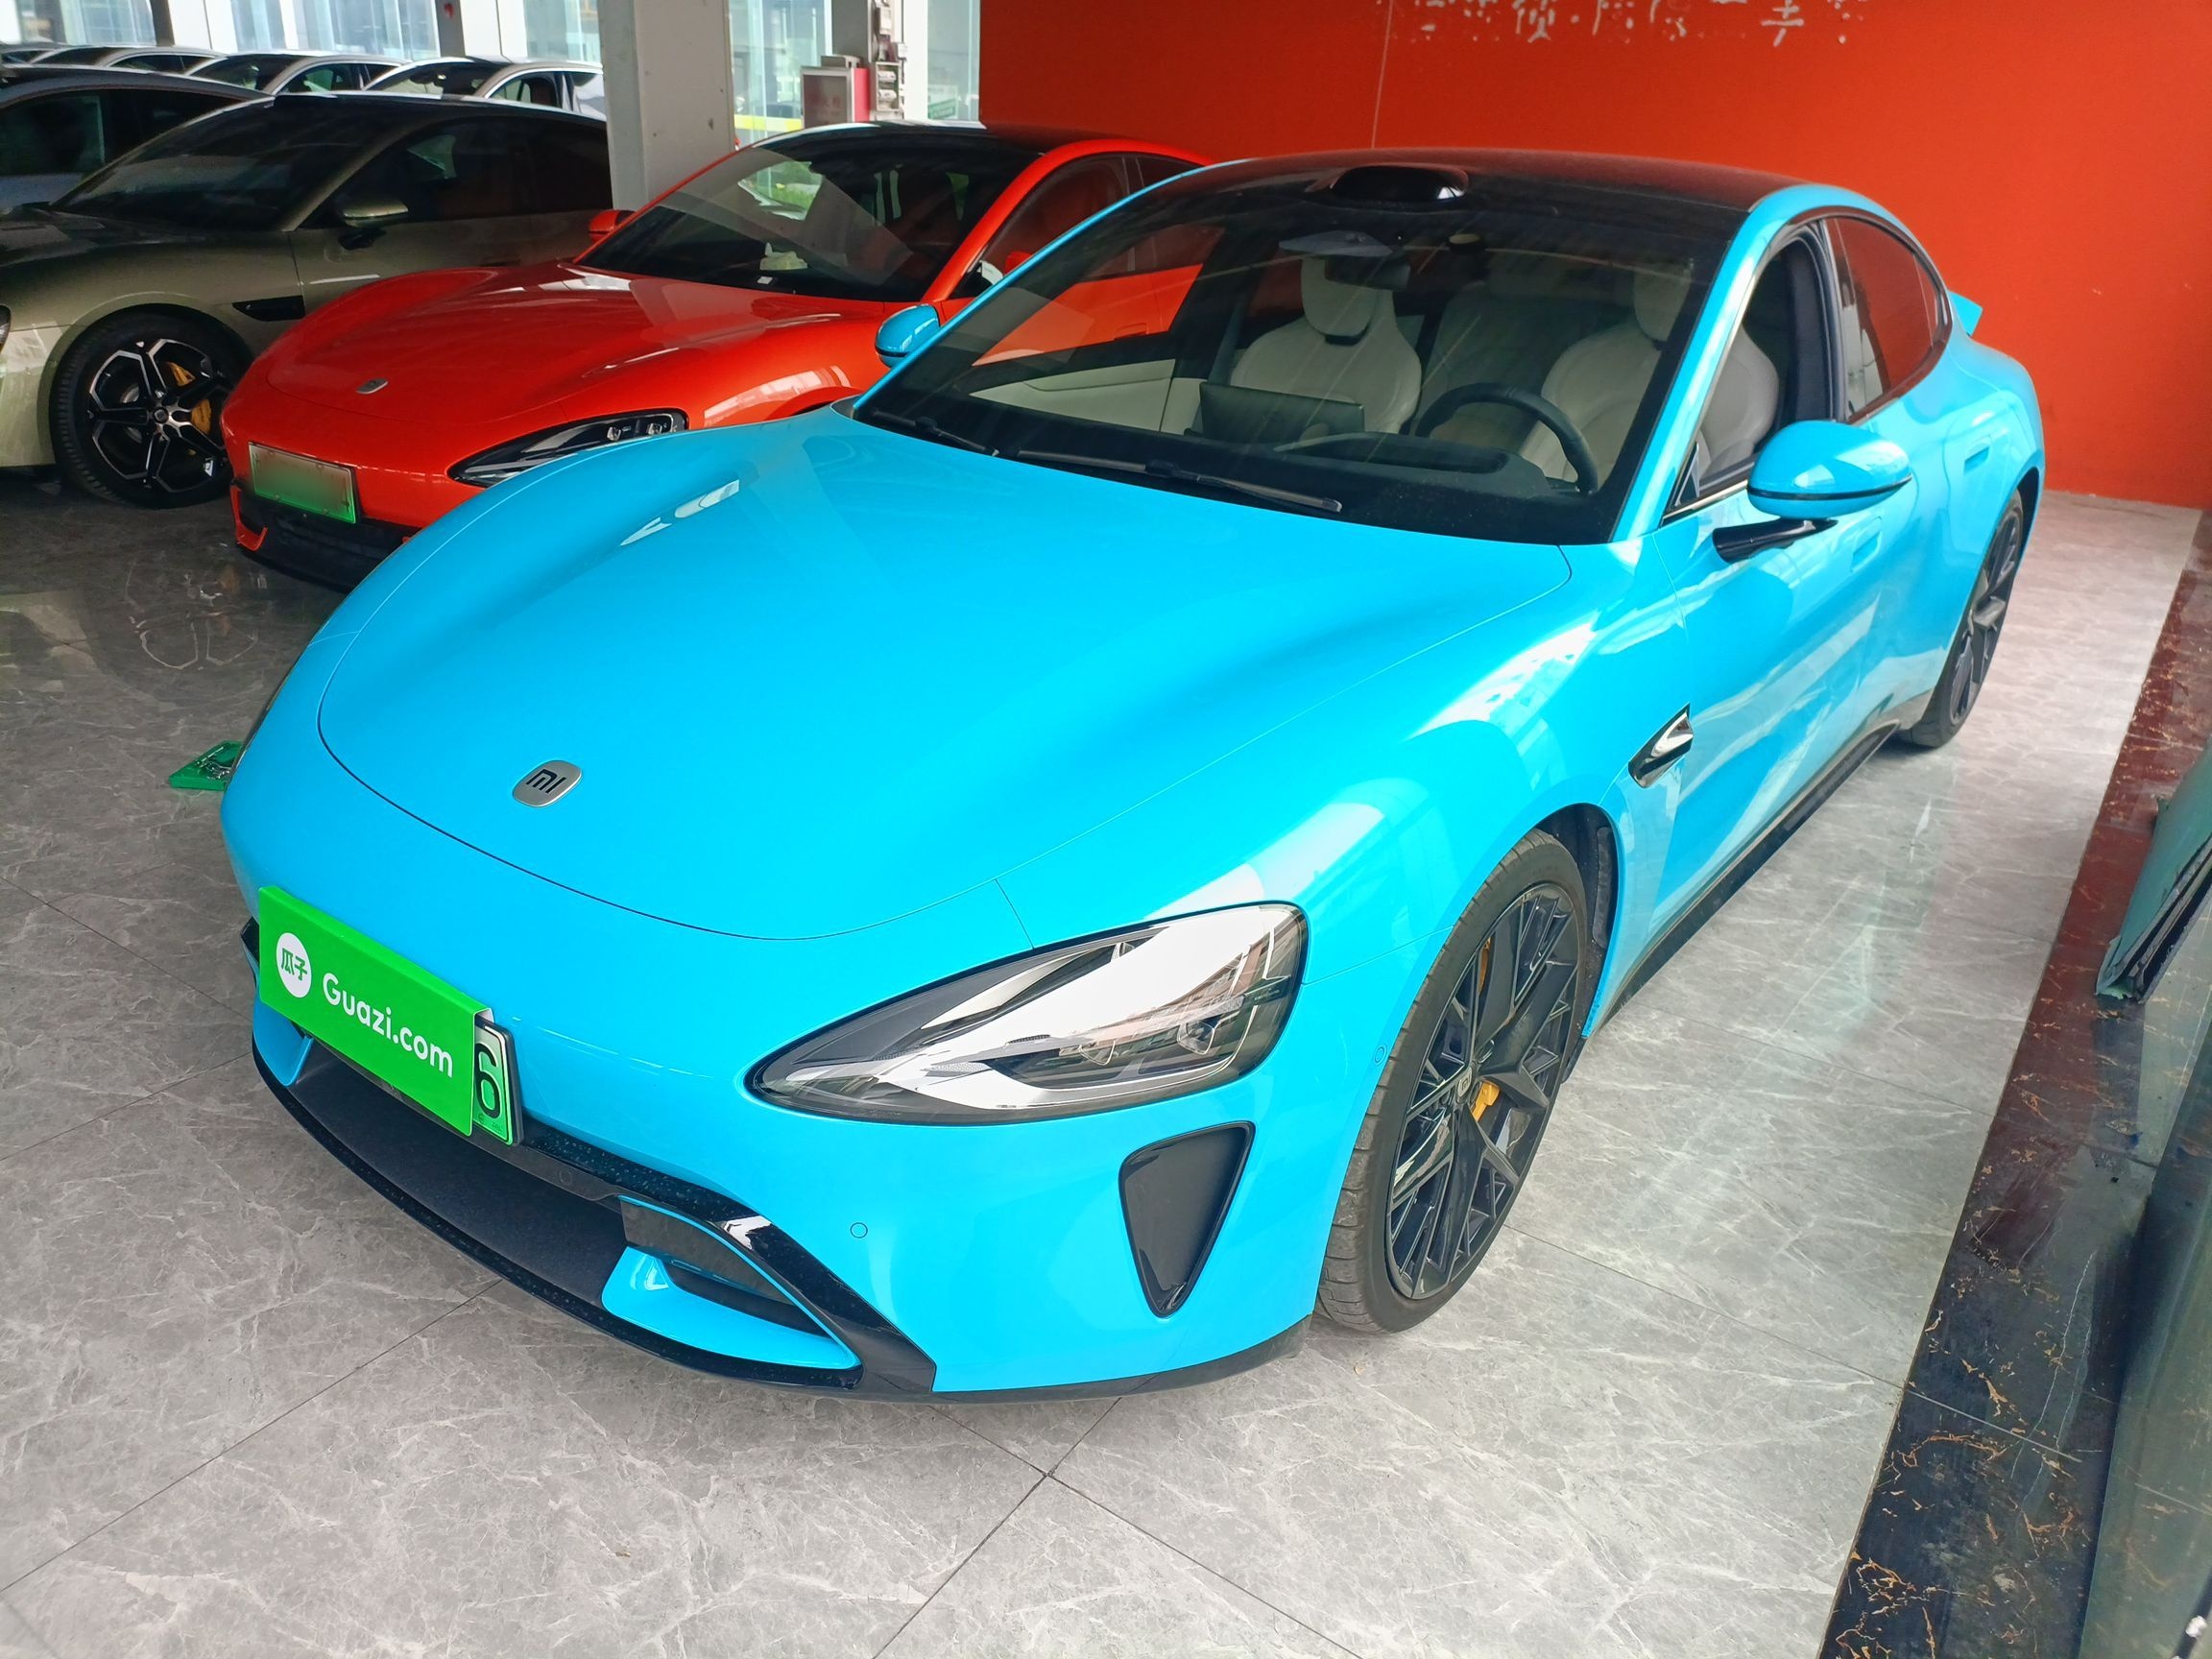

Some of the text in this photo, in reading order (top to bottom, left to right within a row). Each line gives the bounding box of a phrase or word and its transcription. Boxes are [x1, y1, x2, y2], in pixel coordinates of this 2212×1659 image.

[281, 948, 308, 981] 瓜子
[323, 973, 453, 1078] Guazi.com
[474, 1043, 501, 1119] 6
